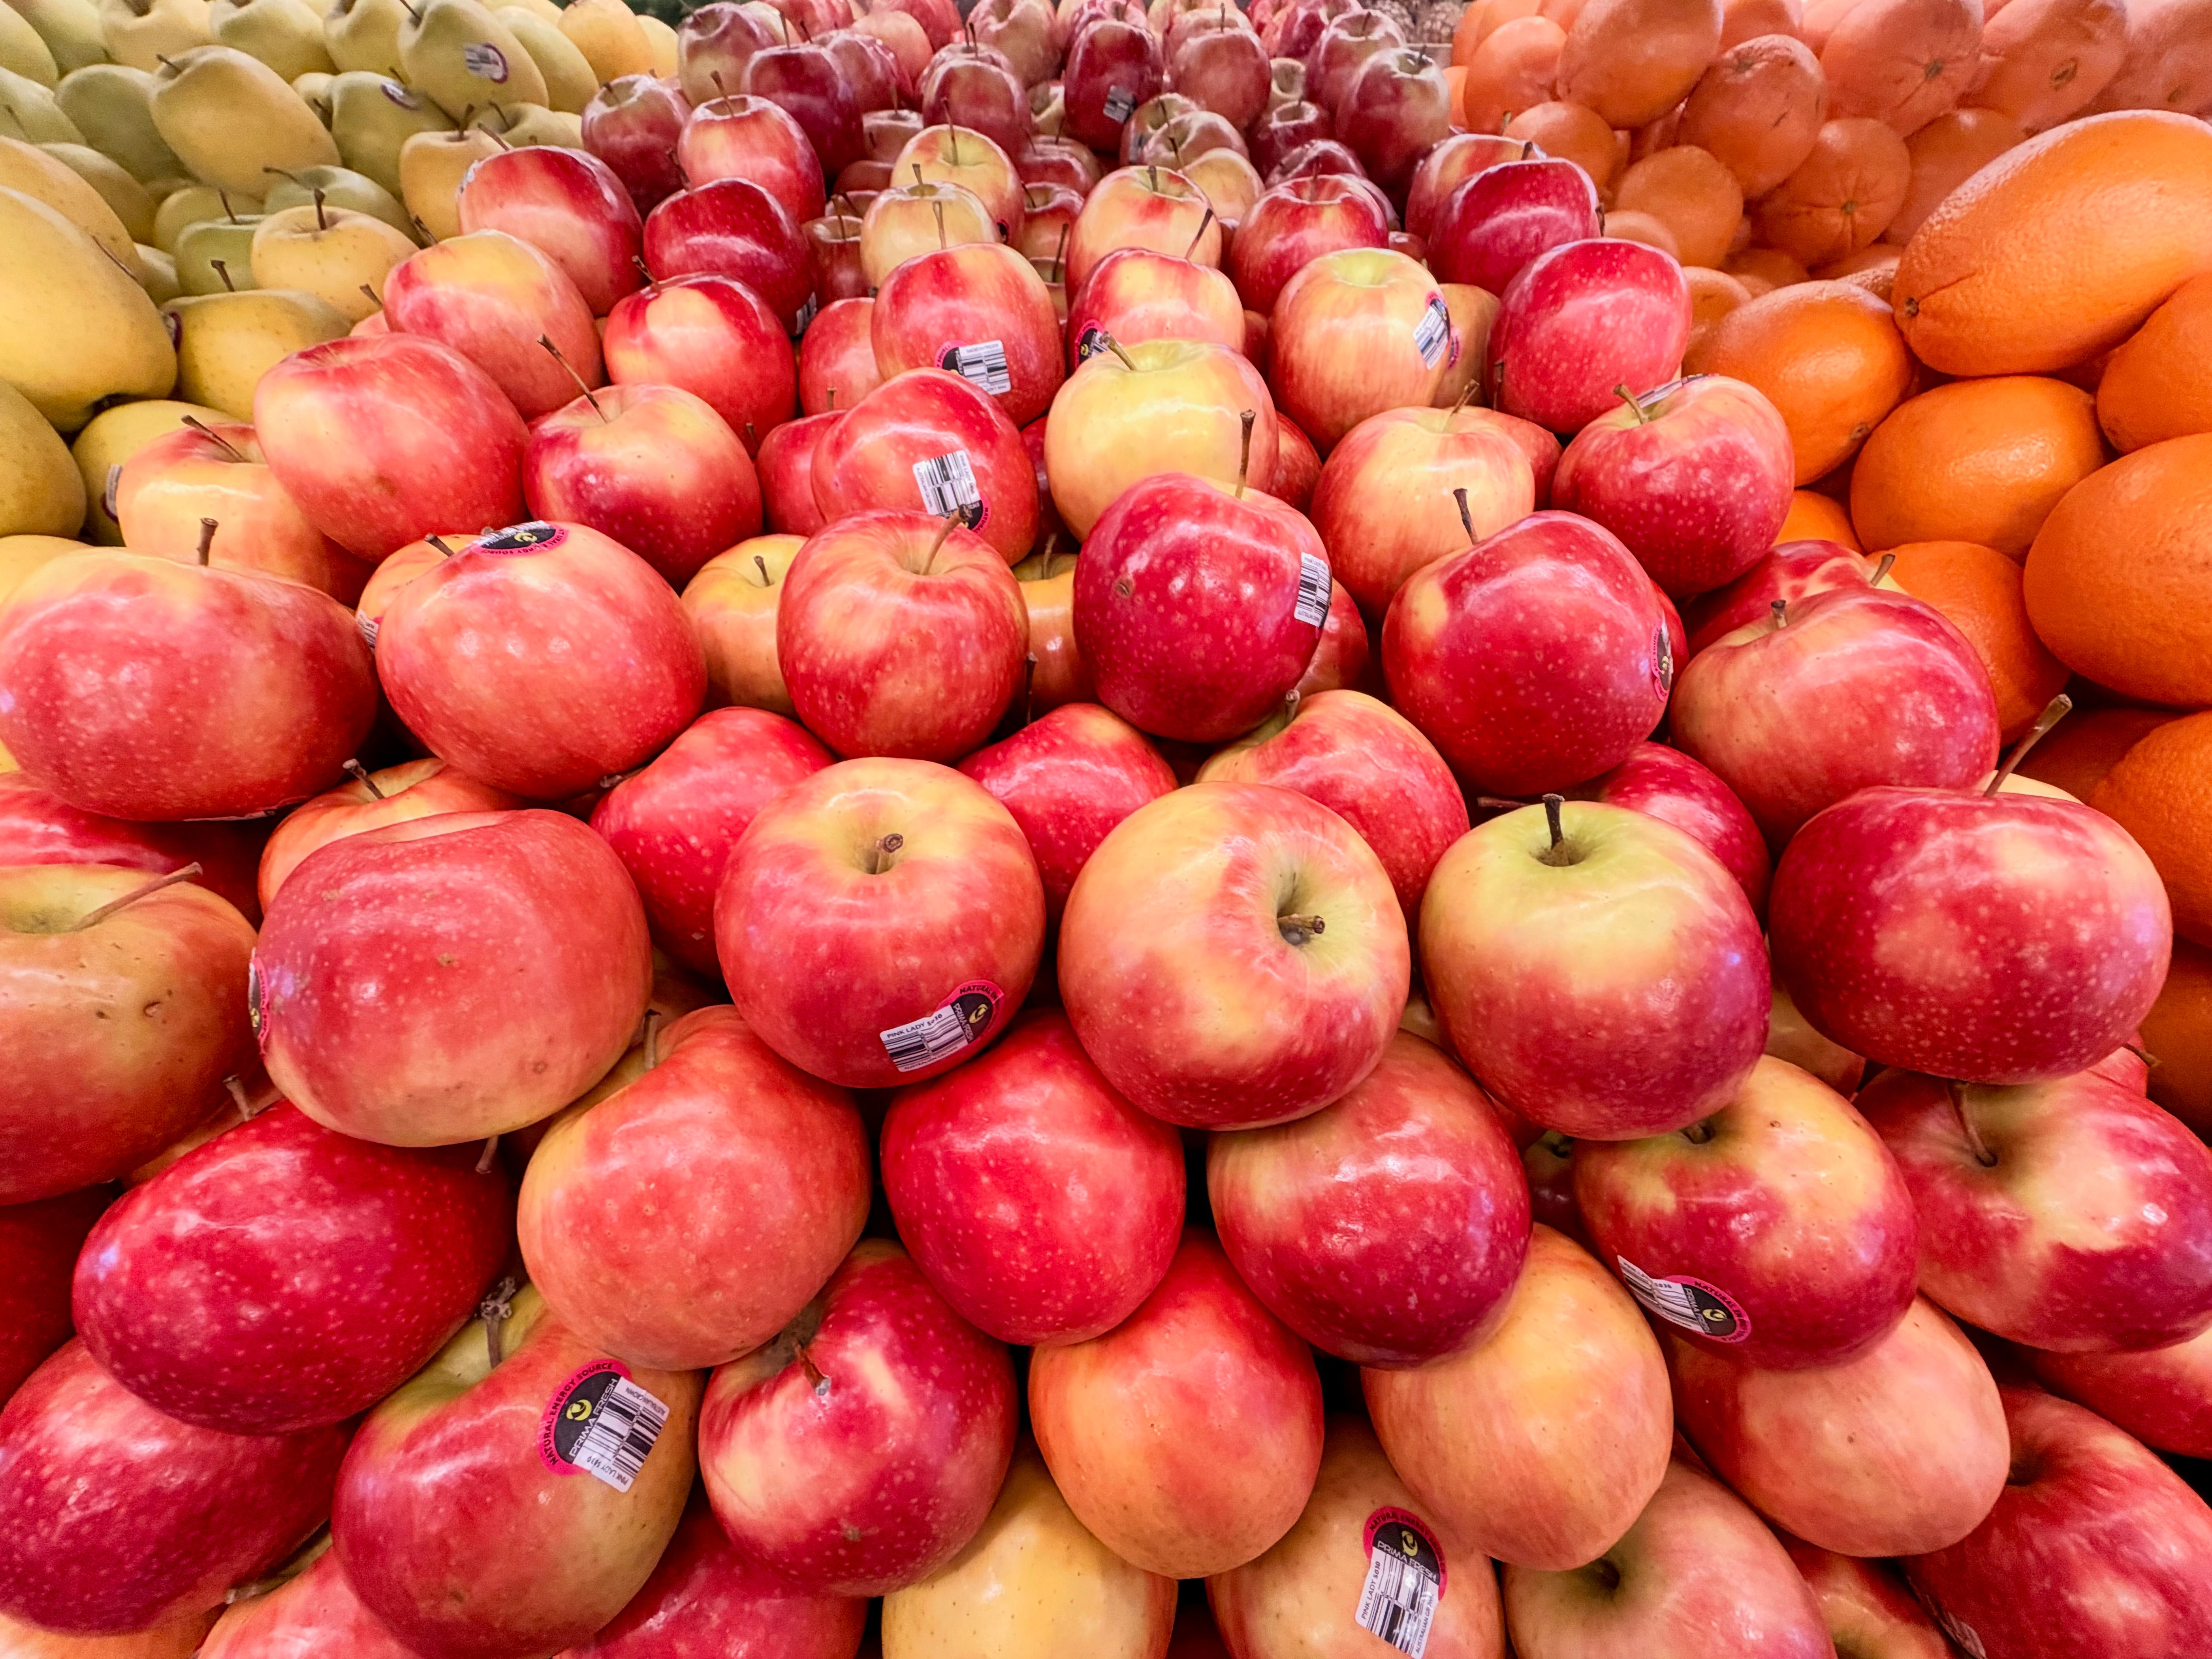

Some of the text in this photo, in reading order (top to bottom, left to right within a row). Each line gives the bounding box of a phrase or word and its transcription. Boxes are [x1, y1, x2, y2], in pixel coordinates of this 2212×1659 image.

[887, 1030, 905, 1038] PINK
[905, 1022, 925, 1033] LADY
[544, 1362, 614, 1466] NATURAL ENERGY SOURCE
[569, 1378, 618, 1457] PRIMA FRESH
[601, 1463, 617, 1477] LADY
[616, 1473, 629, 1486] PINK
[1377, 1540, 1437, 1582] PRIMA FRESH
[1361, 1605, 1371, 1620] PINK
[1367, 1580, 1377, 1600] LADY
[1415, 1617, 1430, 1654] AUSTRALIAN
